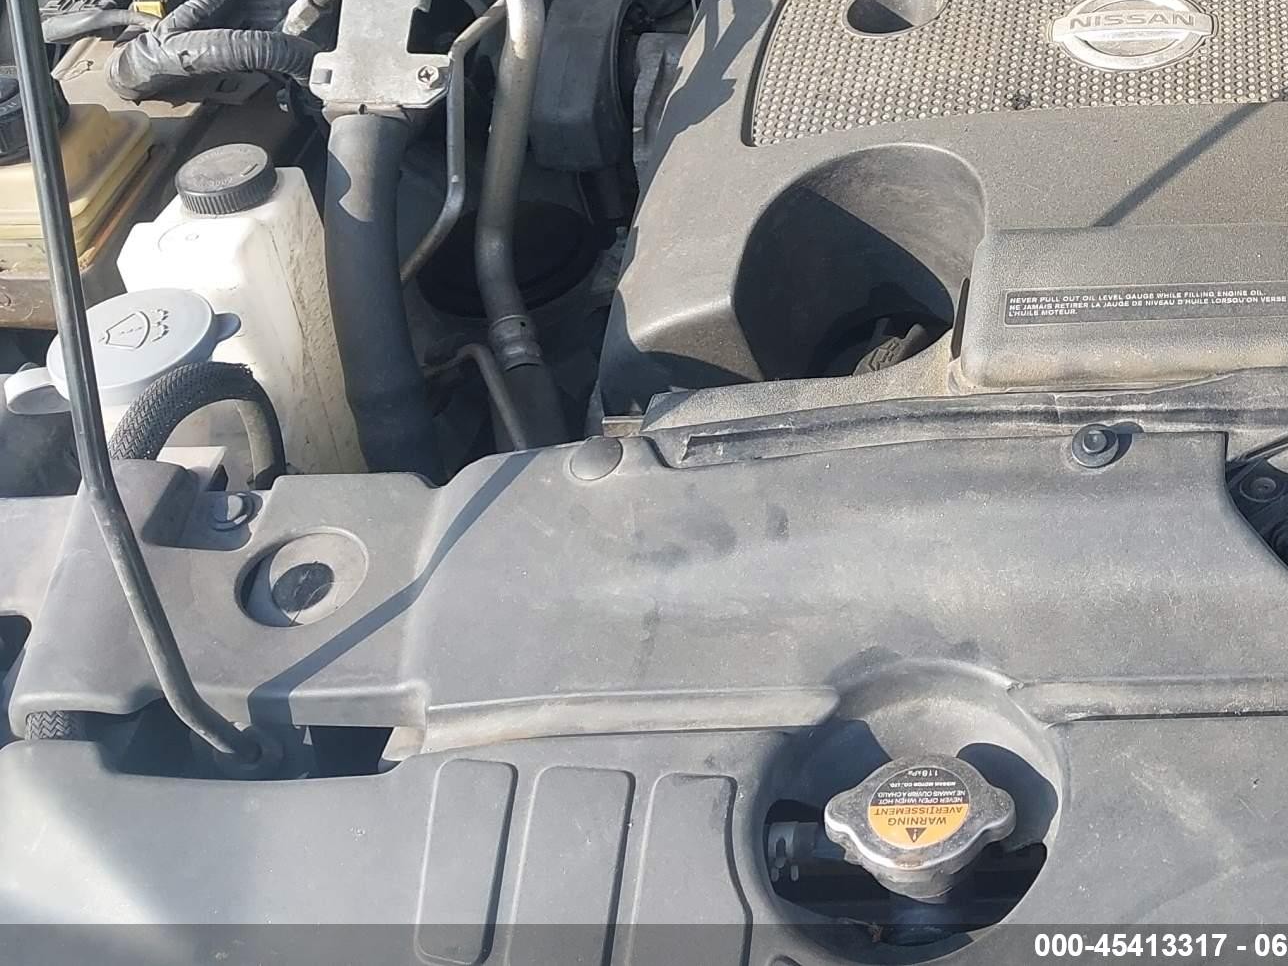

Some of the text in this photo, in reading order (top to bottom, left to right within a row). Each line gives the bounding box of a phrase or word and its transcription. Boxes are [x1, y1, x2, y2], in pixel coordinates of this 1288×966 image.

[1068, 11, 1196, 30] NISSAN
[940, 796, 963, 804] NEVER
[874, 806, 962, 816] AVERTISSEMENT
[887, 817, 947, 827] WARNING
